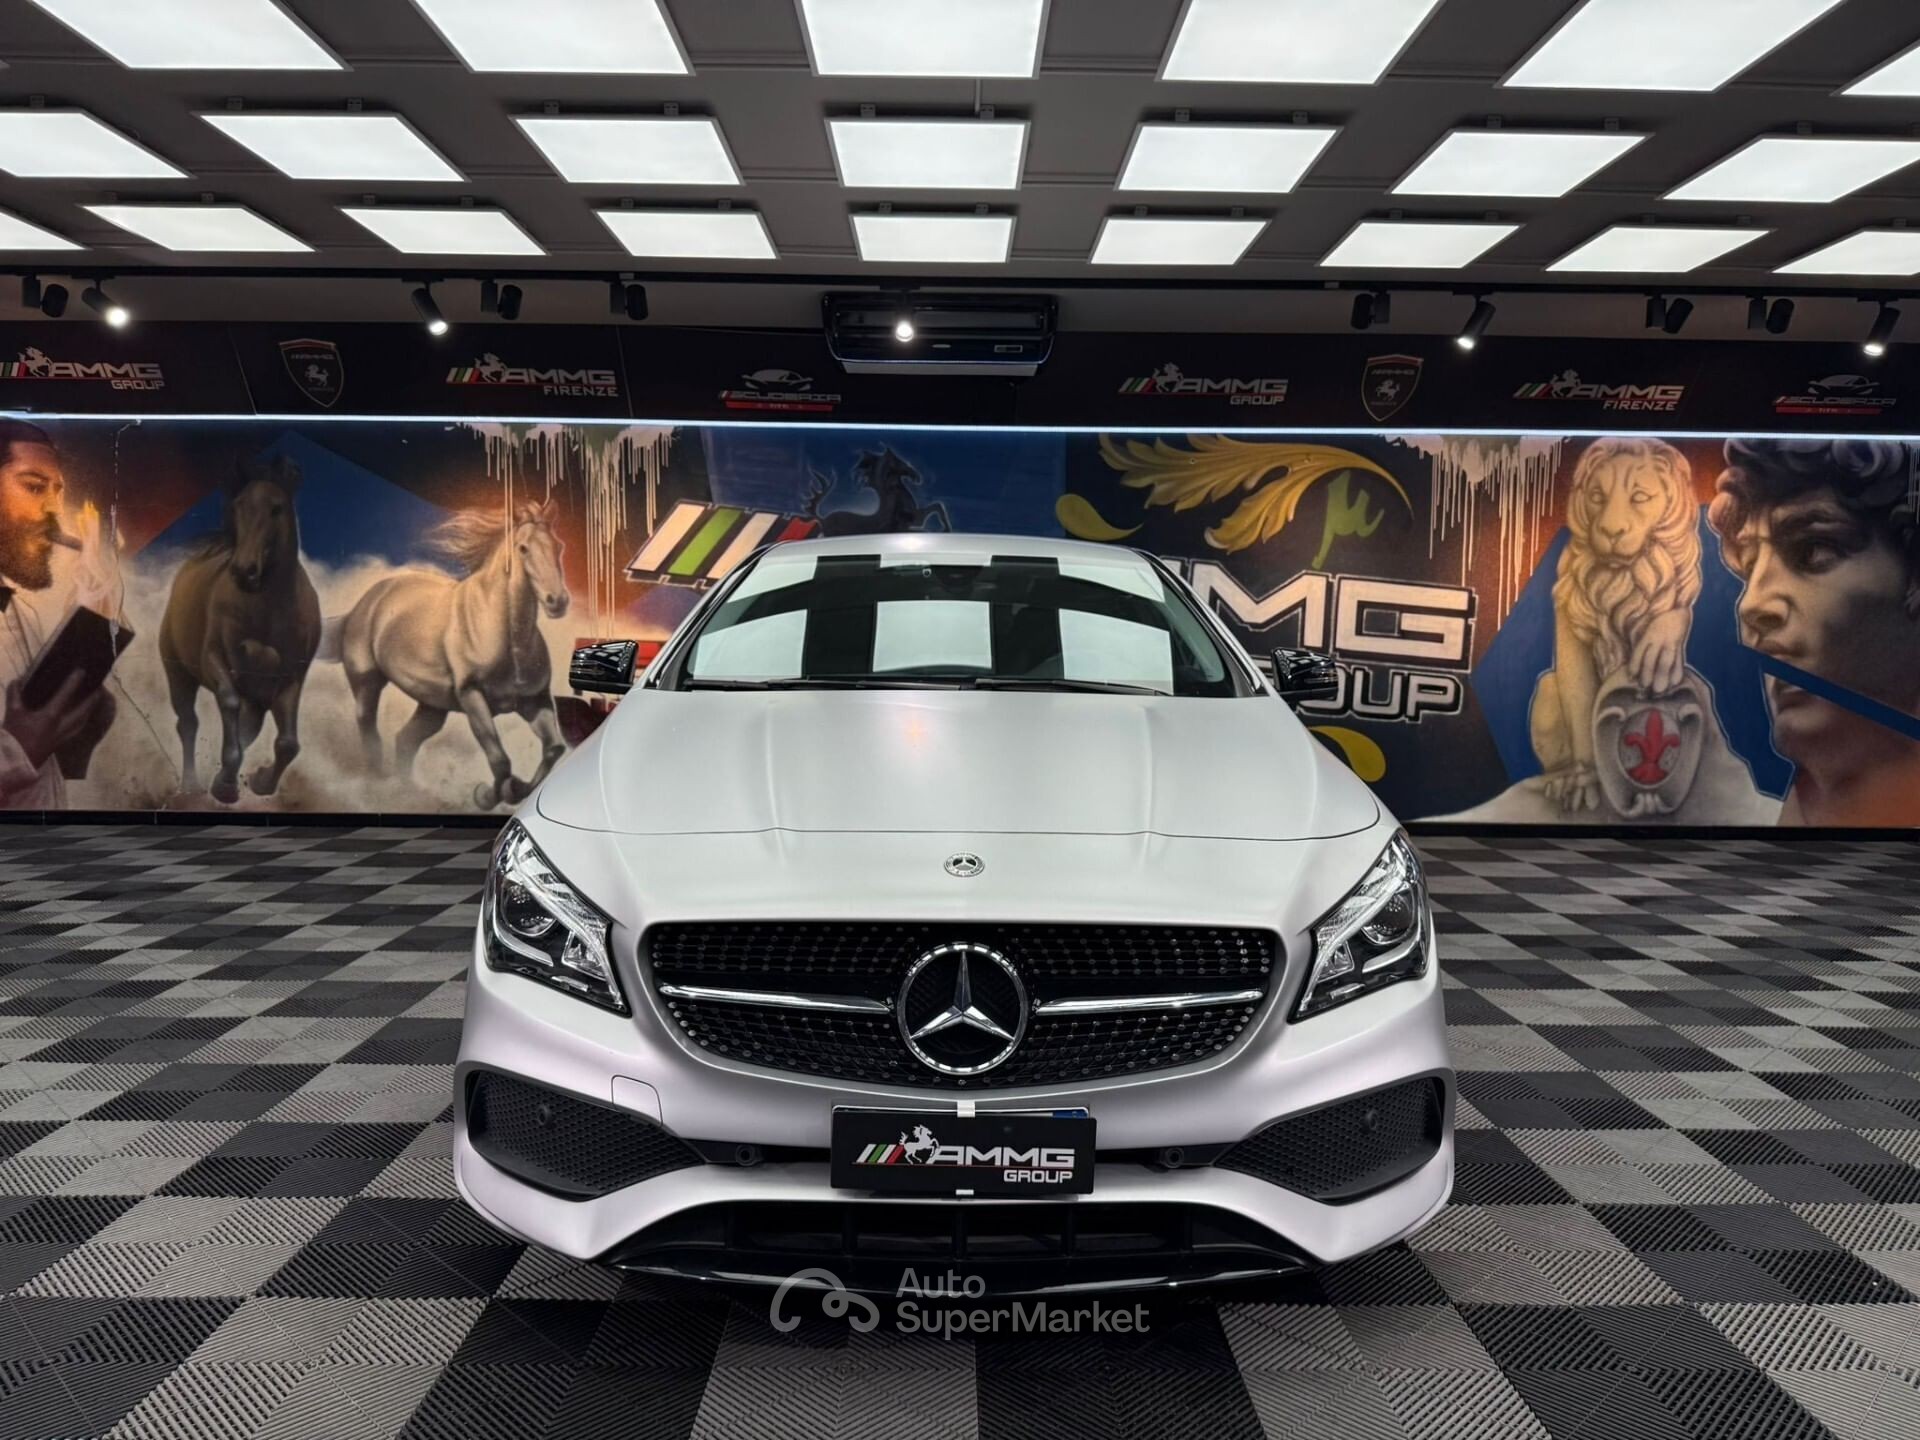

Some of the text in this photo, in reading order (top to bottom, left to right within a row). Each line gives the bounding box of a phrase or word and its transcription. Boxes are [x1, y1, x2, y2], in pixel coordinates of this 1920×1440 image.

[49, 362, 164, 379] AMMG
[500, 368, 617, 385] AMMG
[111, 380, 165, 390] GROUP
[543, 386, 619, 397] FIRENZE
[1171, 378, 1289, 394] AMMG
[1567, 384, 1685, 399] AMMG
[1229, 395, 1285, 405] GROUP
[1602, 400, 1679, 411] FIRENZE
[1160, 556, 1478, 673] MG
[927, 1145, 1076, 1168] AMMG
[1003, 1169, 1074, 1184] GROUP
